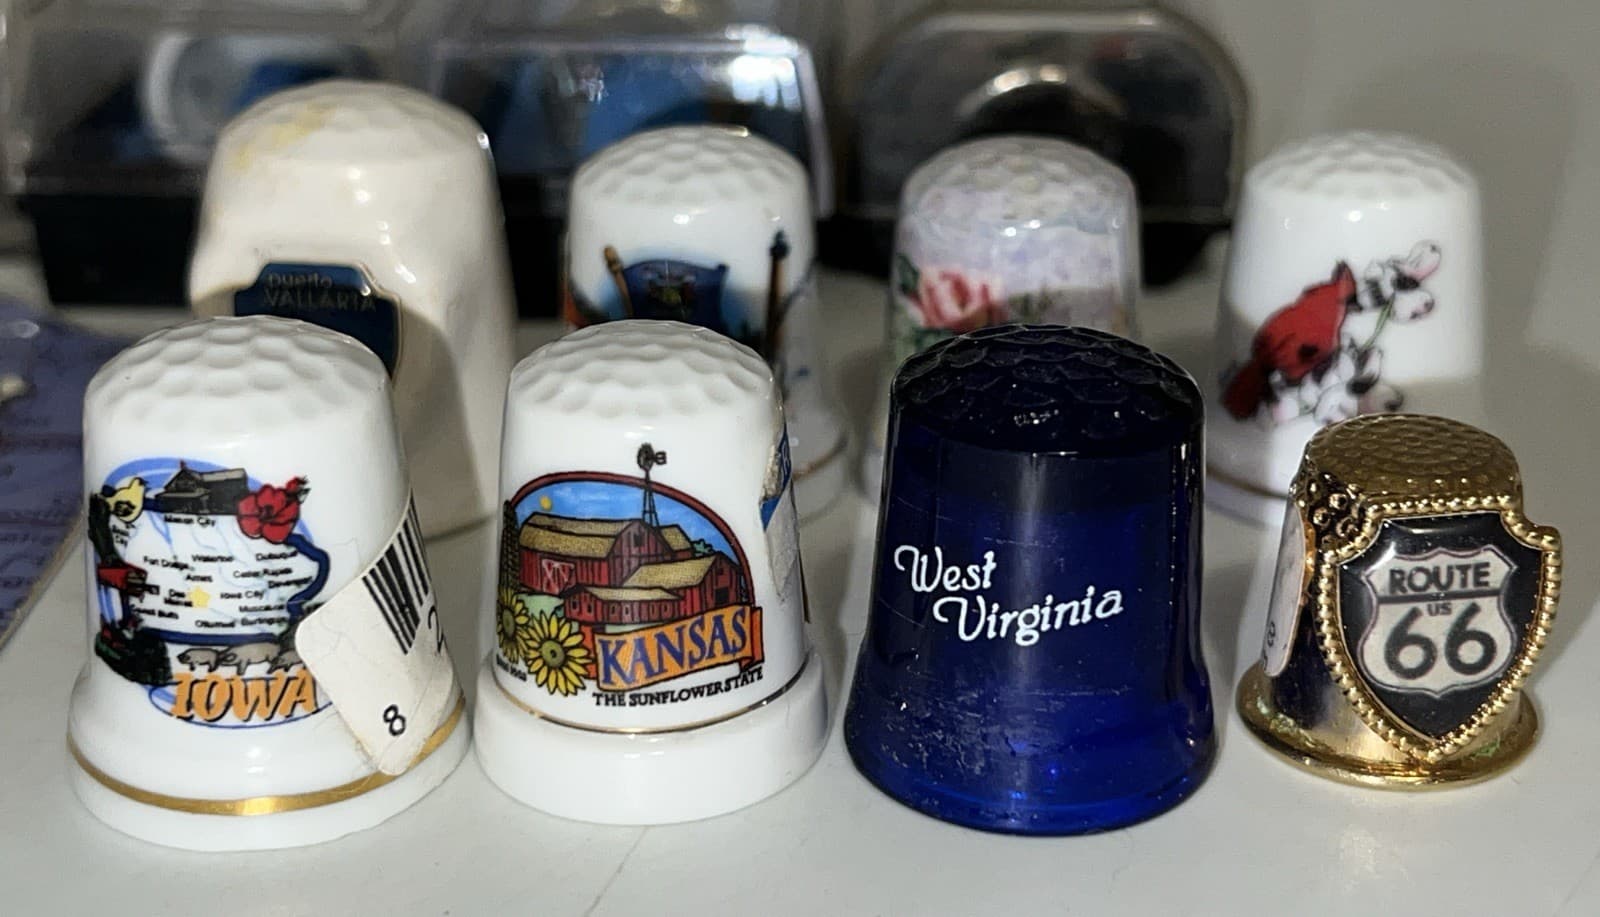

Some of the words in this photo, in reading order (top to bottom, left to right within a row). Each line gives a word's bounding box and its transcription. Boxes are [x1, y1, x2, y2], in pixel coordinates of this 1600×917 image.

[893, 544, 998, 593] West
[1388, 561, 1491, 595] ROUTE
[932, 585, 1125, 647] Virginia
[1426, 602, 1453, 617] US
[598, 608, 748, 686] KANSAS
[1384, 601, 1498, 680] 66
[171, 667, 318, 722] IOWA
[592, 692, 627, 707] THE
[628, 683, 725, 707] SUNFLOWER
[724, 665, 764, 692] STATE
[382, 703, 407, 737] 8
